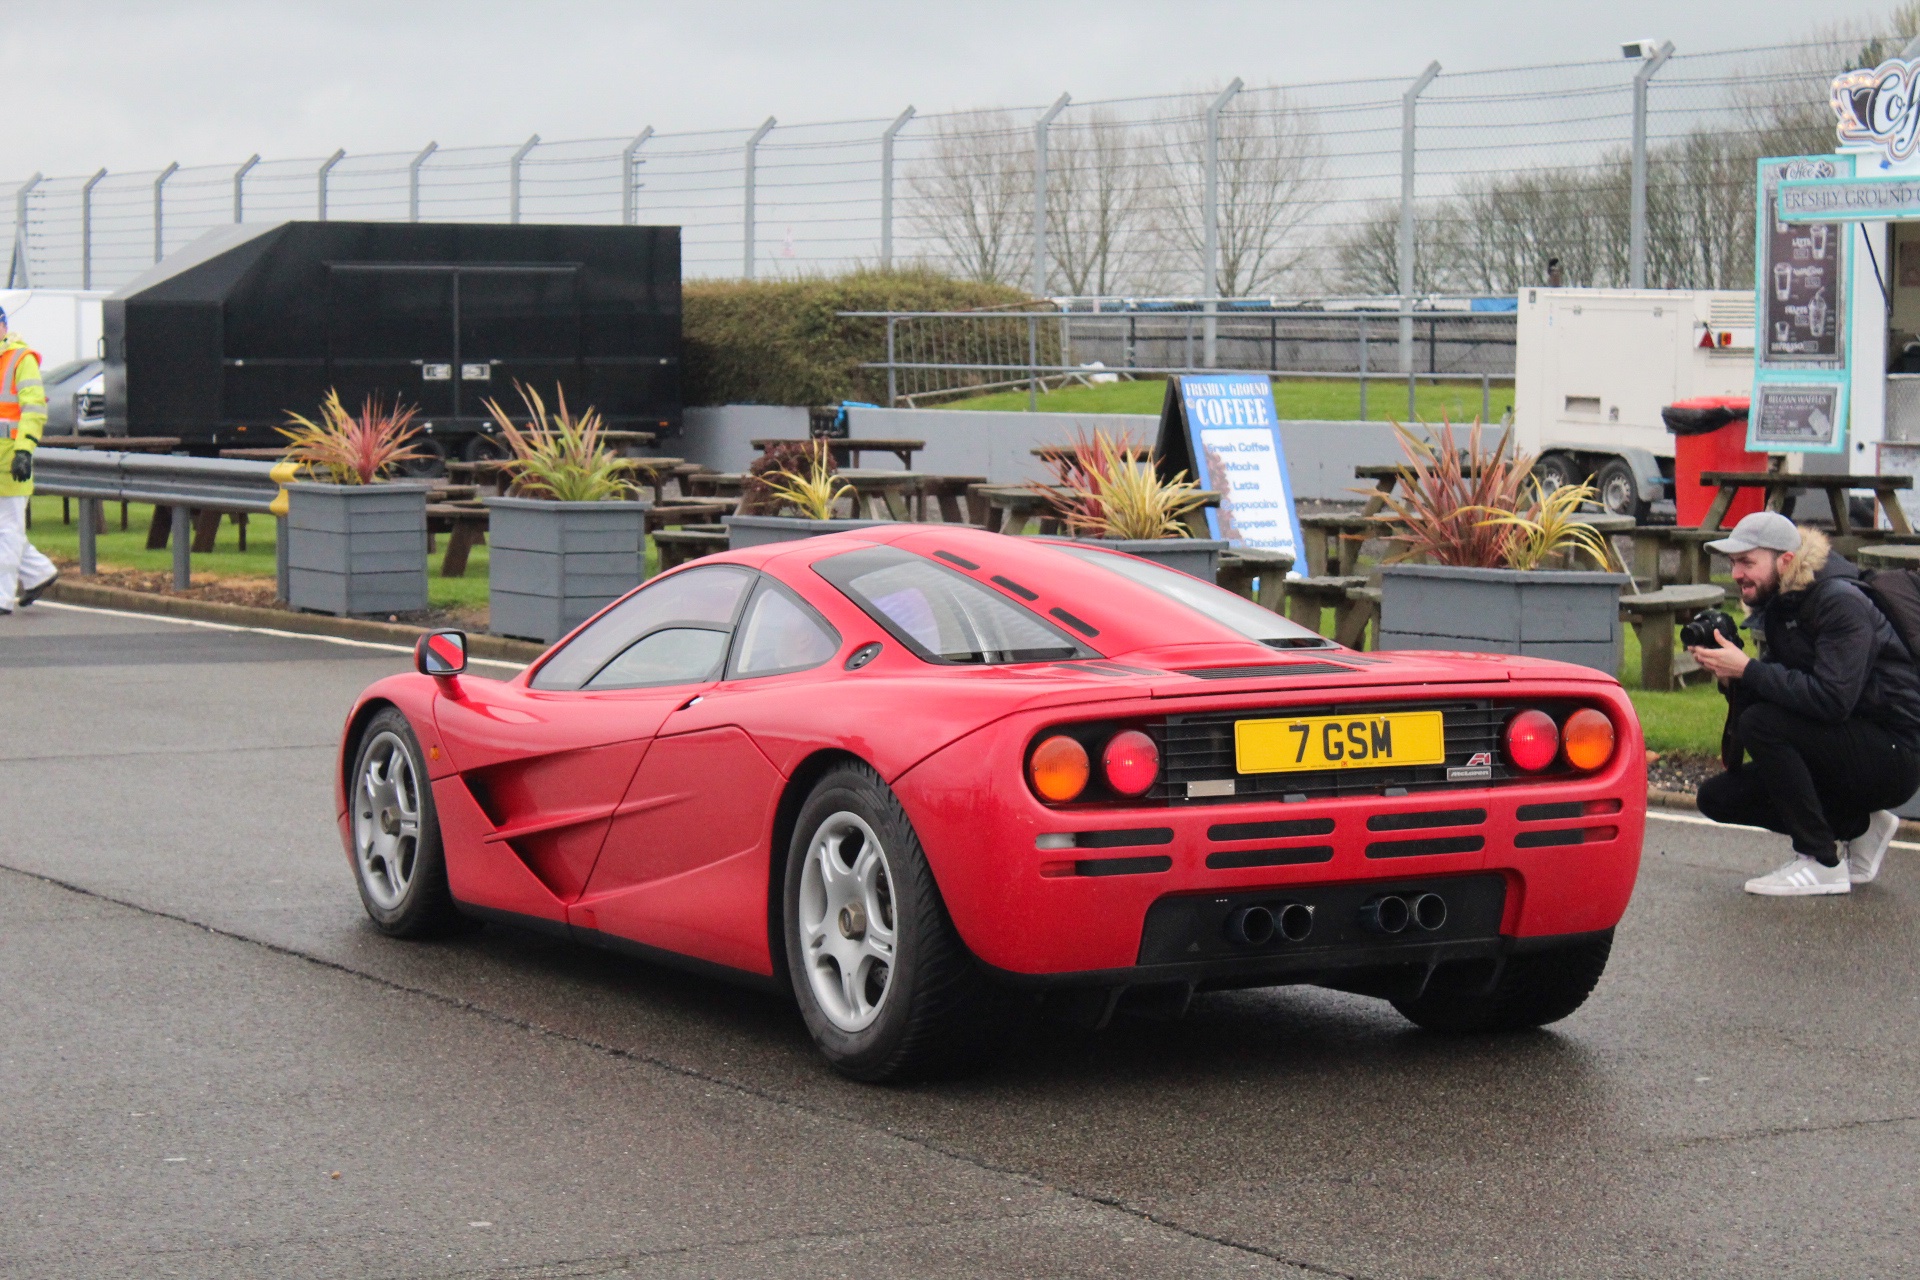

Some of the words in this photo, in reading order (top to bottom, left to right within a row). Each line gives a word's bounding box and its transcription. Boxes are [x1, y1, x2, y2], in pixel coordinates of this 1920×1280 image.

[1785, 190, 1840, 208] FRESHLY
[1845, 187, 1912, 205] GROUND
[1184, 382, 1227, 397] FRESHLY
[1228, 382, 1269, 396] GROUND
[1195, 398, 1270, 426] COFFEE
[1206, 444, 1236, 452] Fresh
[1238, 443, 1270, 452] Coffee
[1226, 462, 1260, 471] Mocha
[1220, 499, 1278, 510] Cappuccino
[1231, 519, 1277, 529] Espresso
[1244, 537, 1293, 547] Chocolate
[1288, 724, 1310, 763] 7
[1322, 720, 1393, 761] GSM
